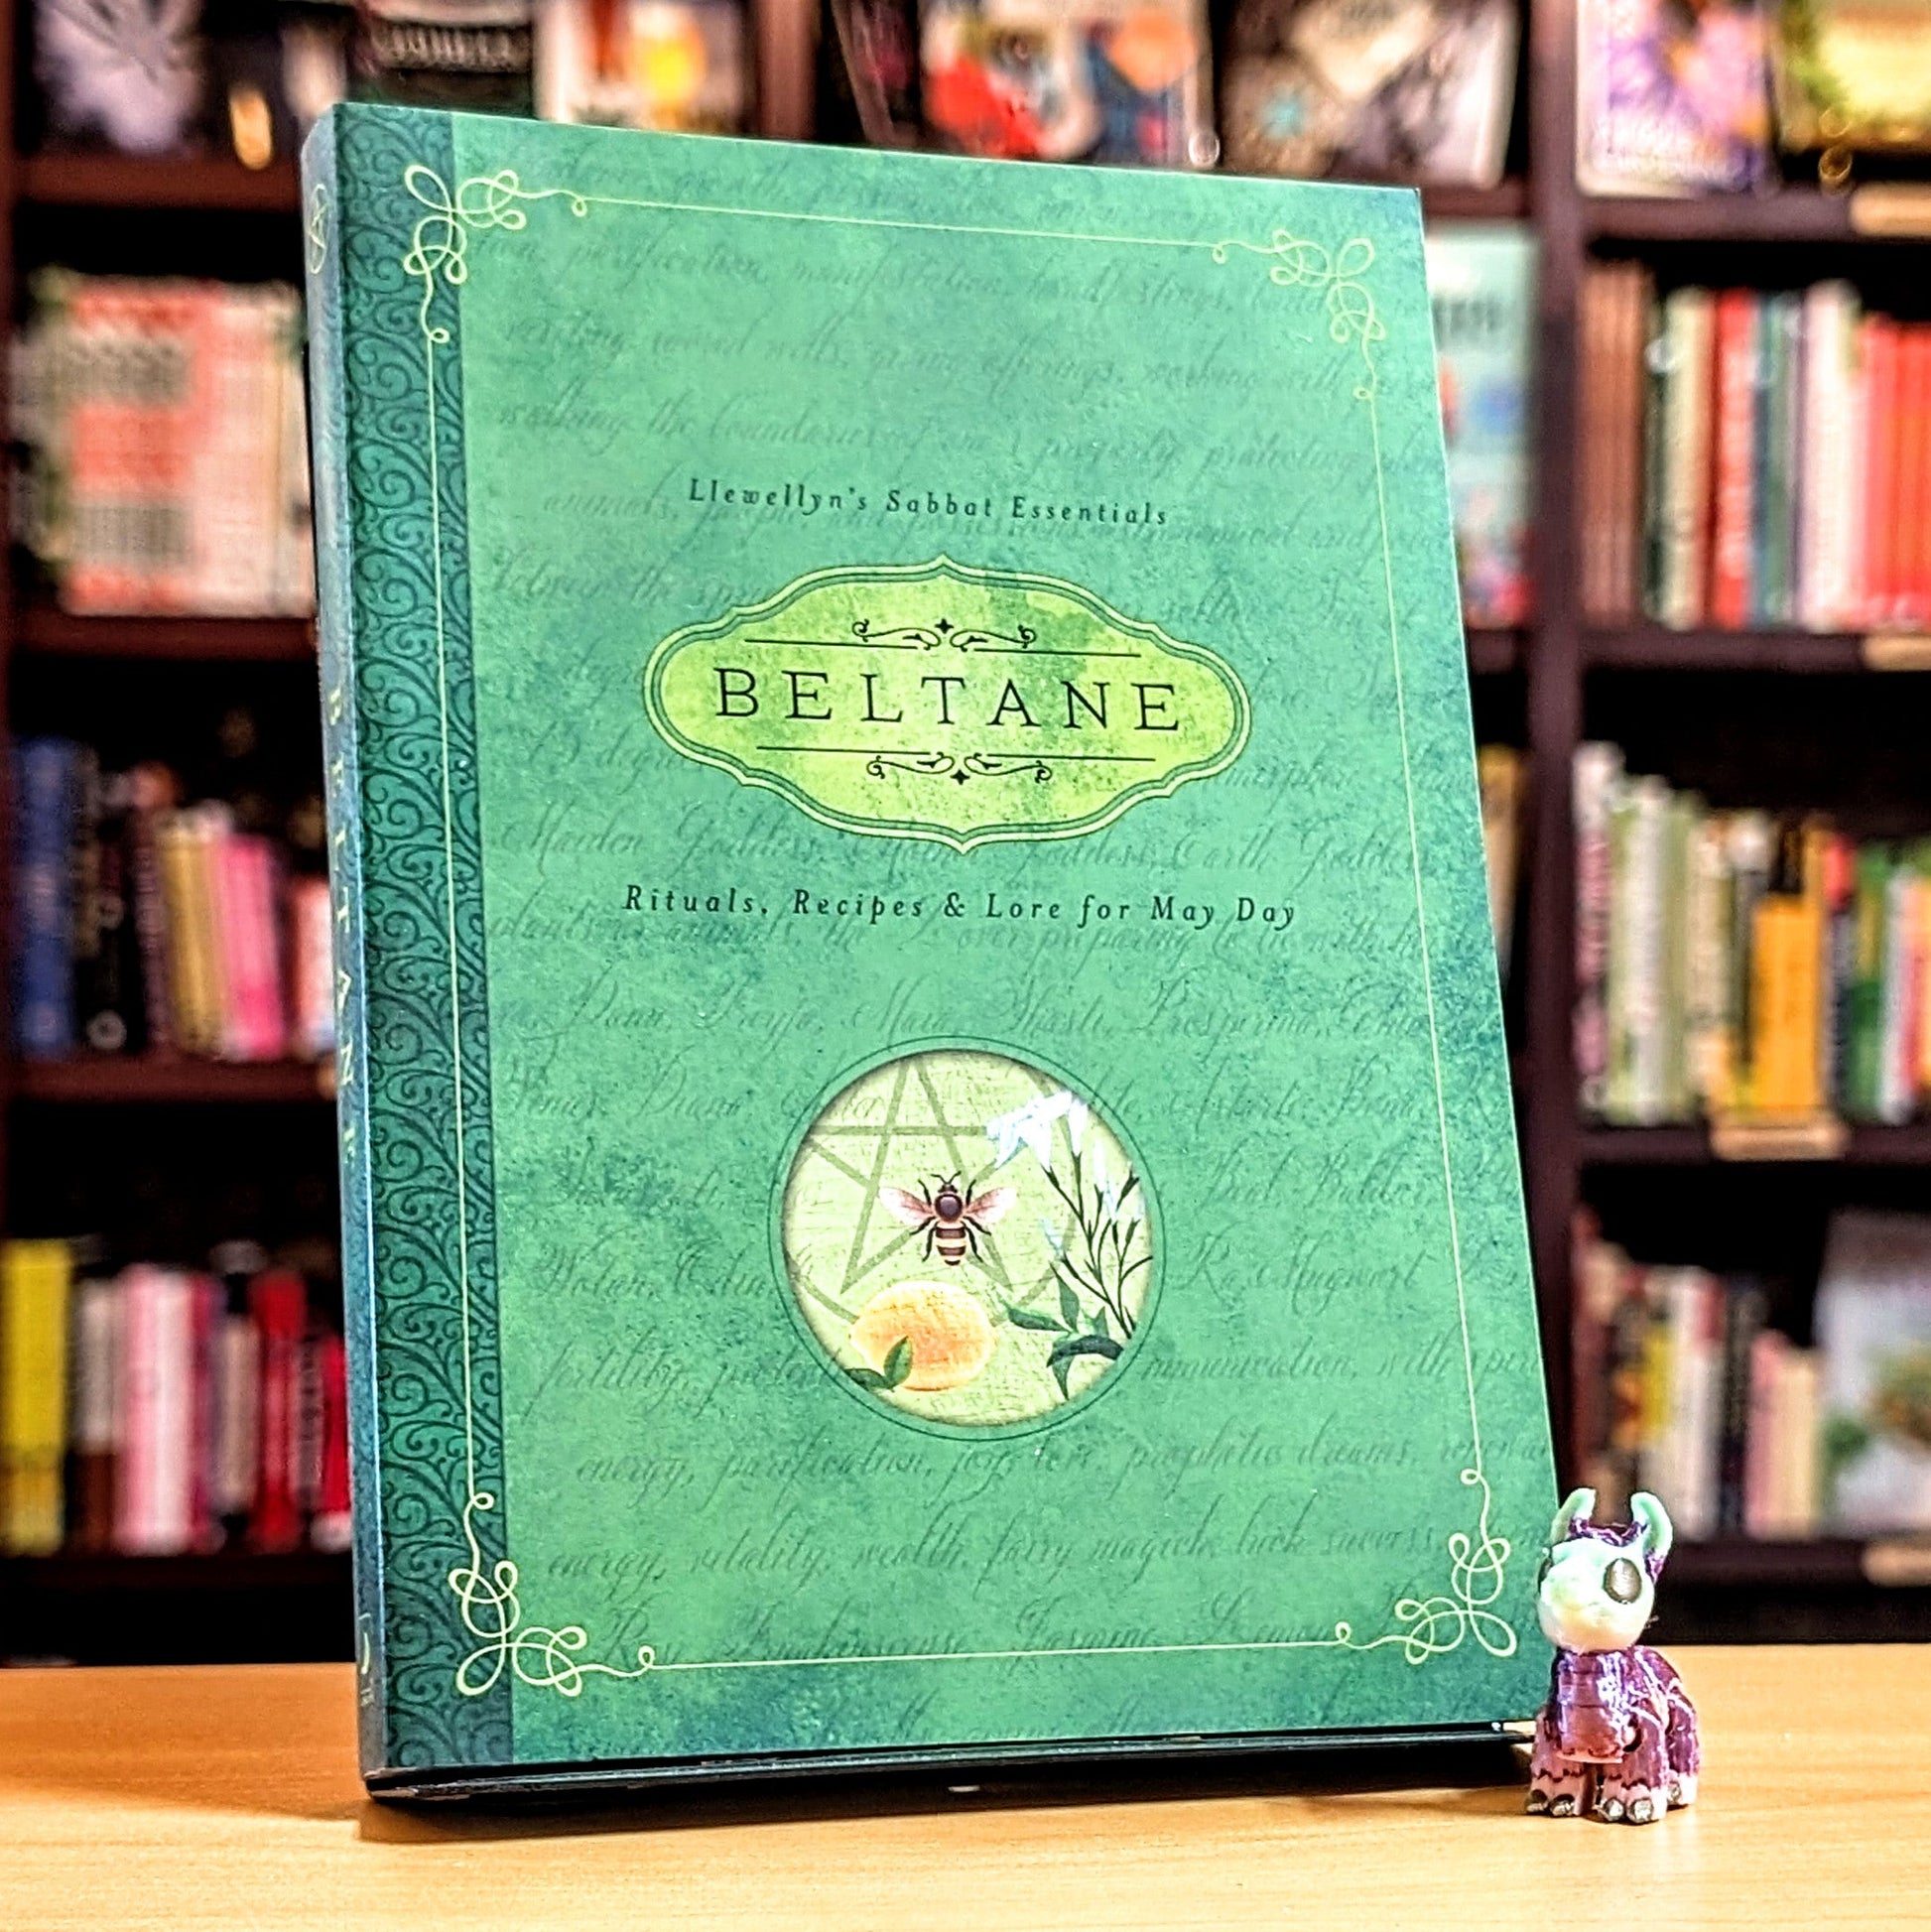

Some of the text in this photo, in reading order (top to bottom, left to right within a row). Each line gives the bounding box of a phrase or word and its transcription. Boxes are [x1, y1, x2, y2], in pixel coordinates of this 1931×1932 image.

[690, 477, 1167, 526] Llewellyn's Sabbat Essentials
[714, 667, 1180, 732] BELTANE
[622, 883, 768, 915] Rituals,
[794, 886, 923, 926] Recipes
[943, 891, 966, 918] &
[986, 893, 1061, 919] Lore
[1077, 893, 1130, 930] for
[1150, 895, 1216, 931] May
[1235, 896, 1296, 932] Day
